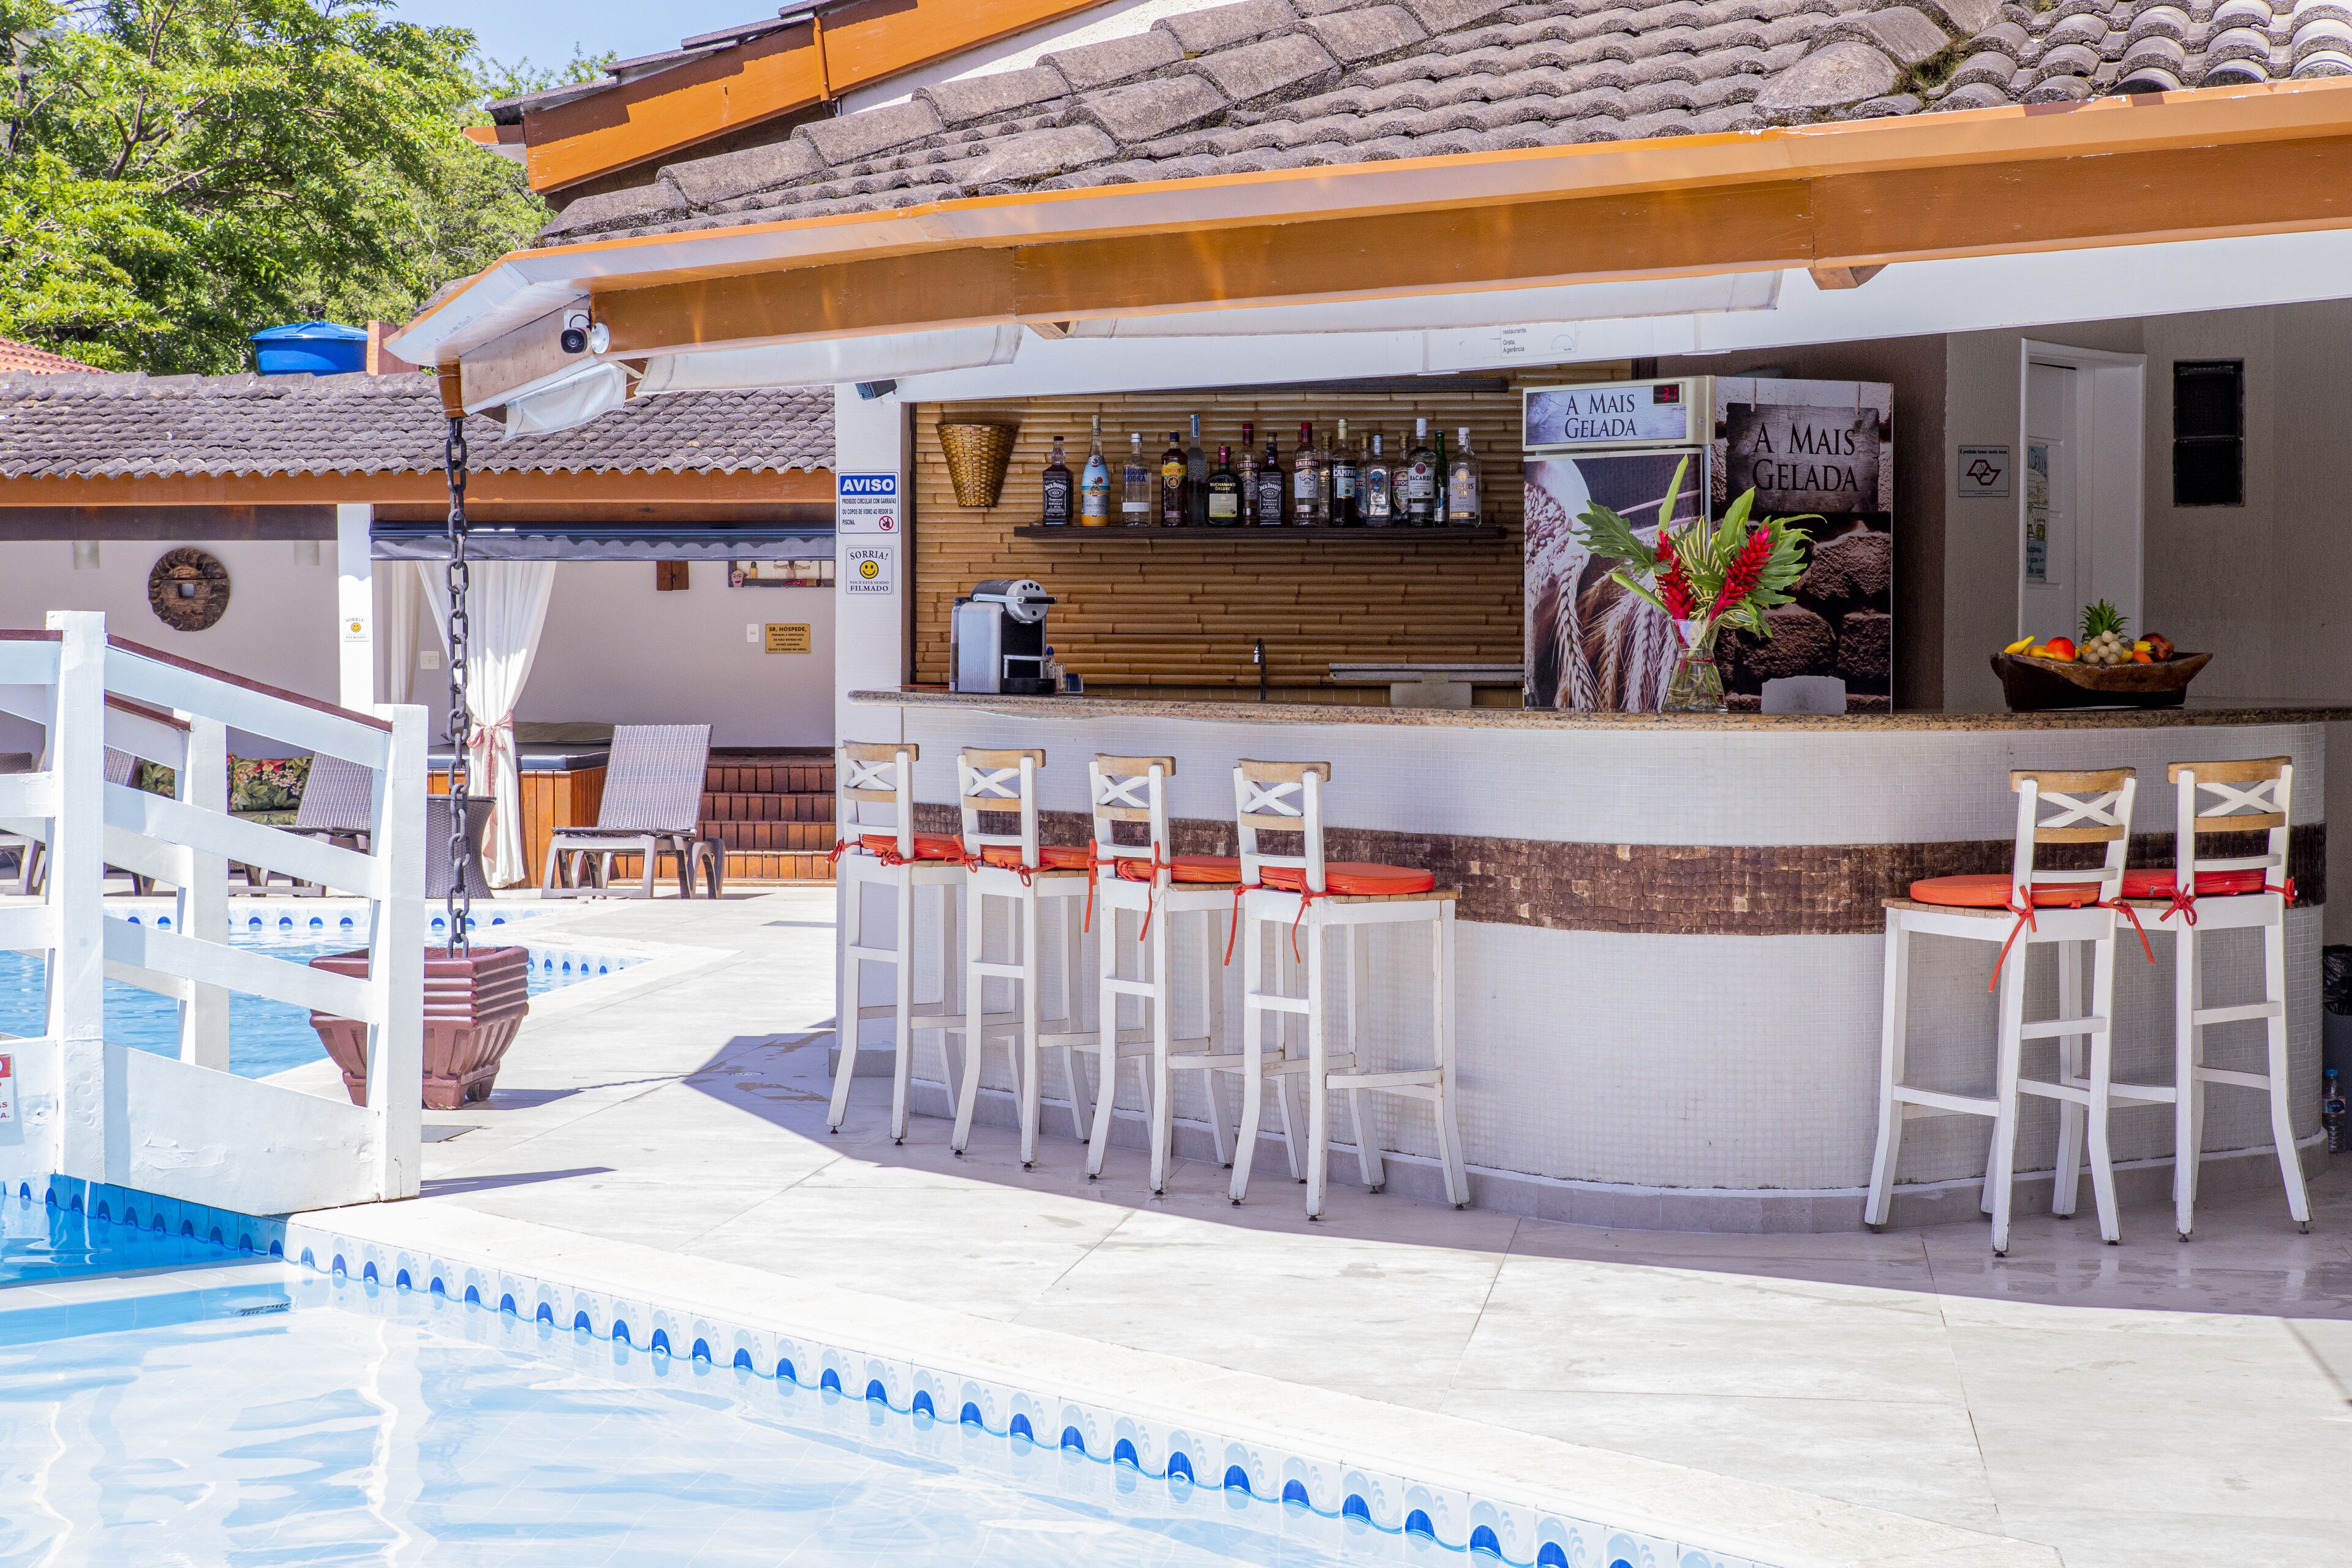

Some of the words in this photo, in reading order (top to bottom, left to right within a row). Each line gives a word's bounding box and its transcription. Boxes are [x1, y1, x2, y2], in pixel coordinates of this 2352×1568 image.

[1662, 387, 1677, 401] 31
[1565, 394, 1580, 415] A
[1752, 422, 1774, 453] A
[842, 479, 894, 491] AVISO
[850, 550, 888, 560] SORRIA!
